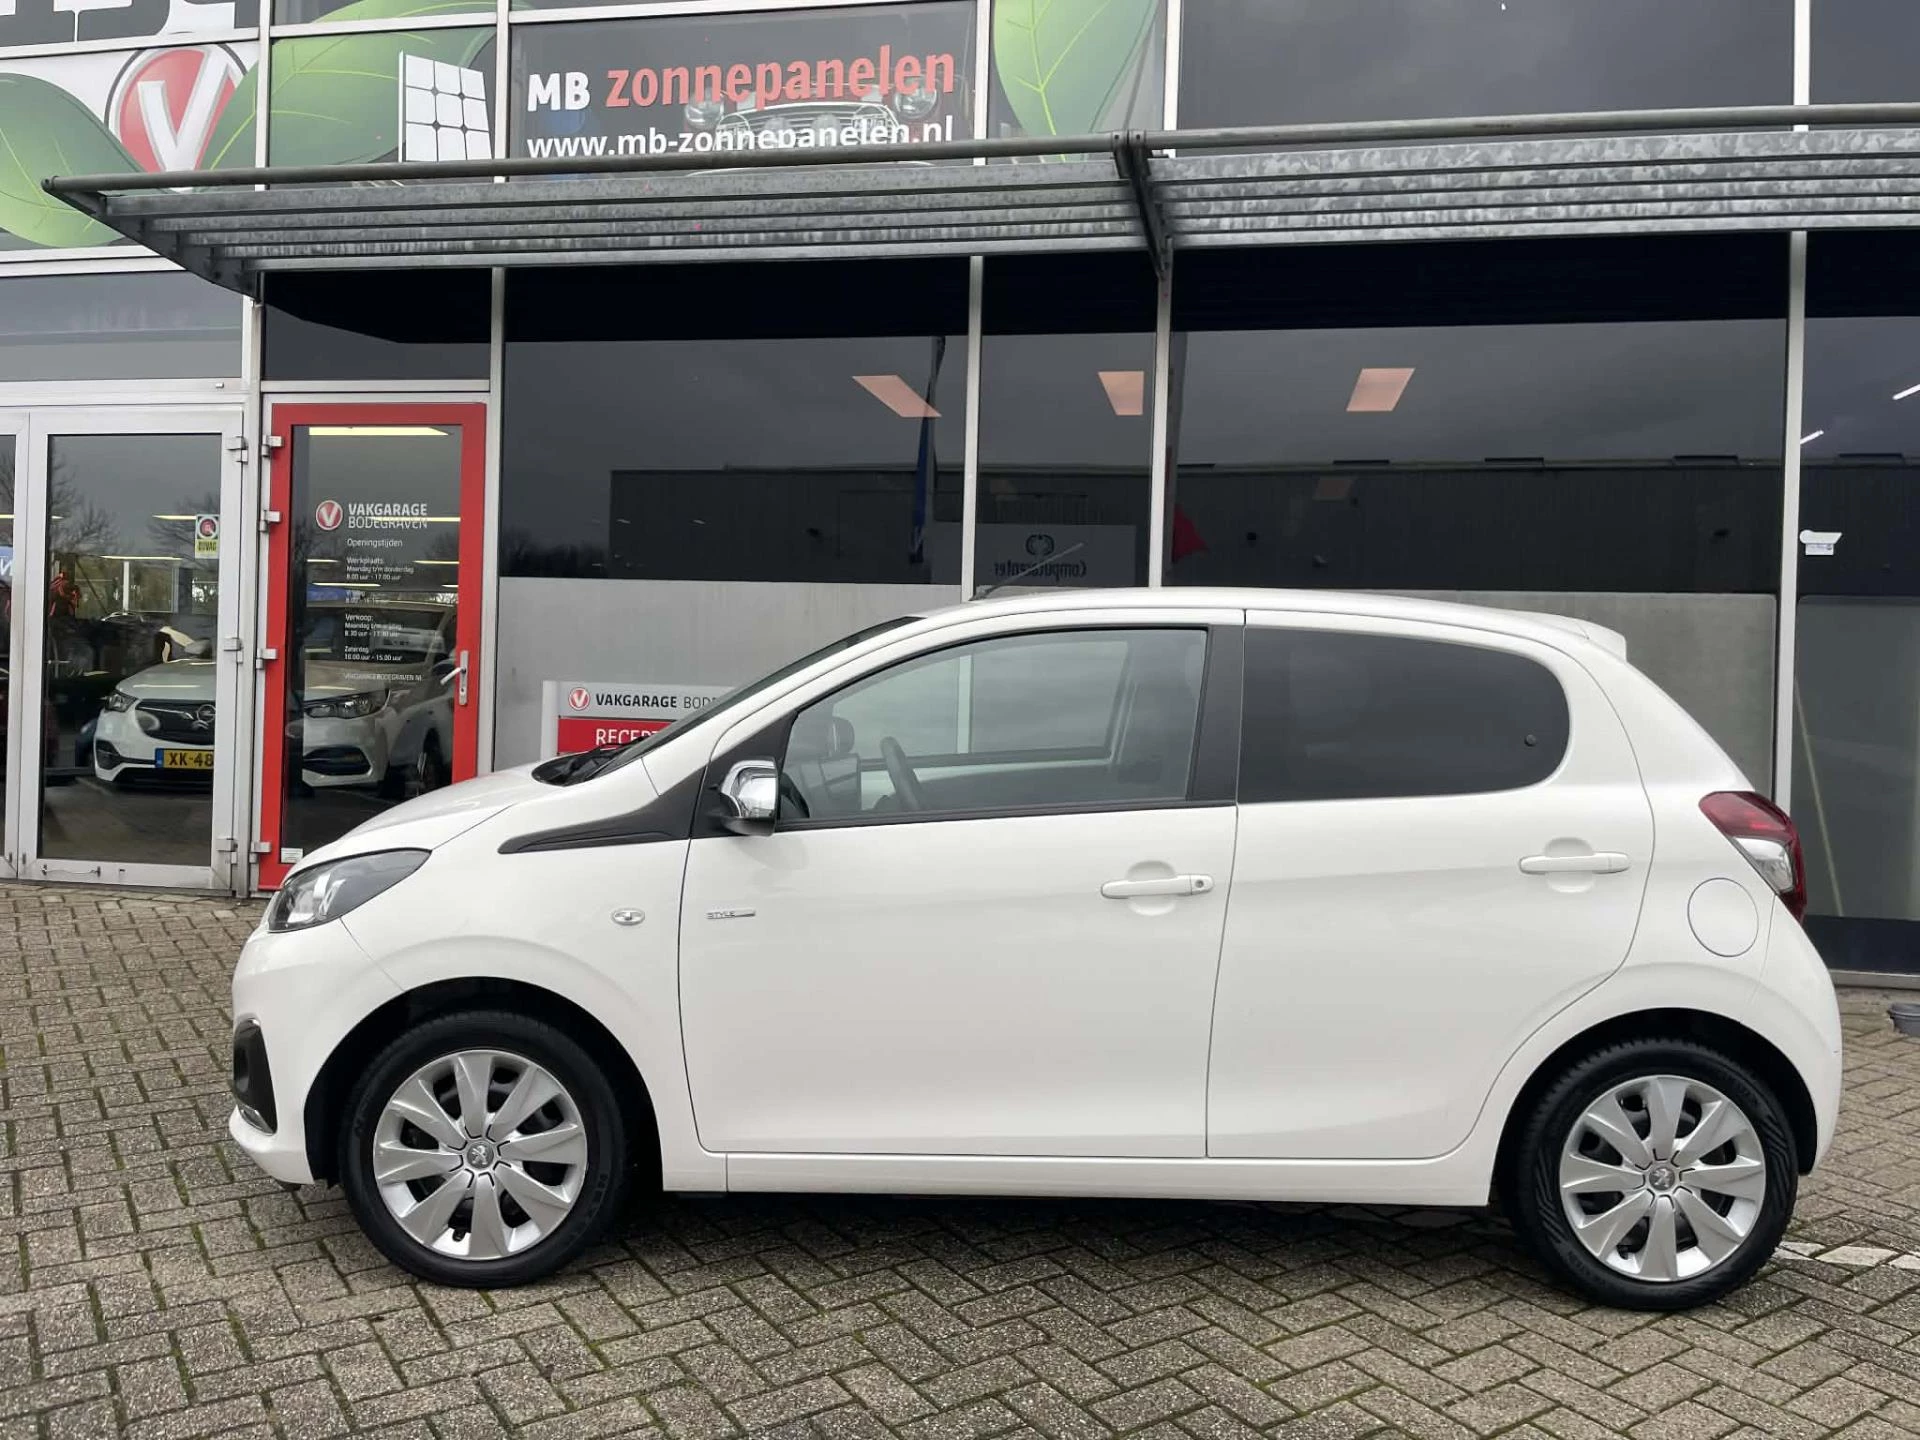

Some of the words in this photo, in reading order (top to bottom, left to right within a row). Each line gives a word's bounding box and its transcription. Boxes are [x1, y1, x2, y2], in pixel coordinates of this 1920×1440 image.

[527, 71, 591, 112] MB
[605, 44, 956, 111] zonnepanelen
[526, 115, 954, 158] www.mb-zonnepanelen.nl
[348, 503, 428, 516] VAKGARAGE
[348, 516, 428, 529] BODEGRAVEN
[347, 538, 403, 548] Openingstijden
[596, 693, 677, 708] VAKGARAGE
[683, 696, 718, 709] BOD
